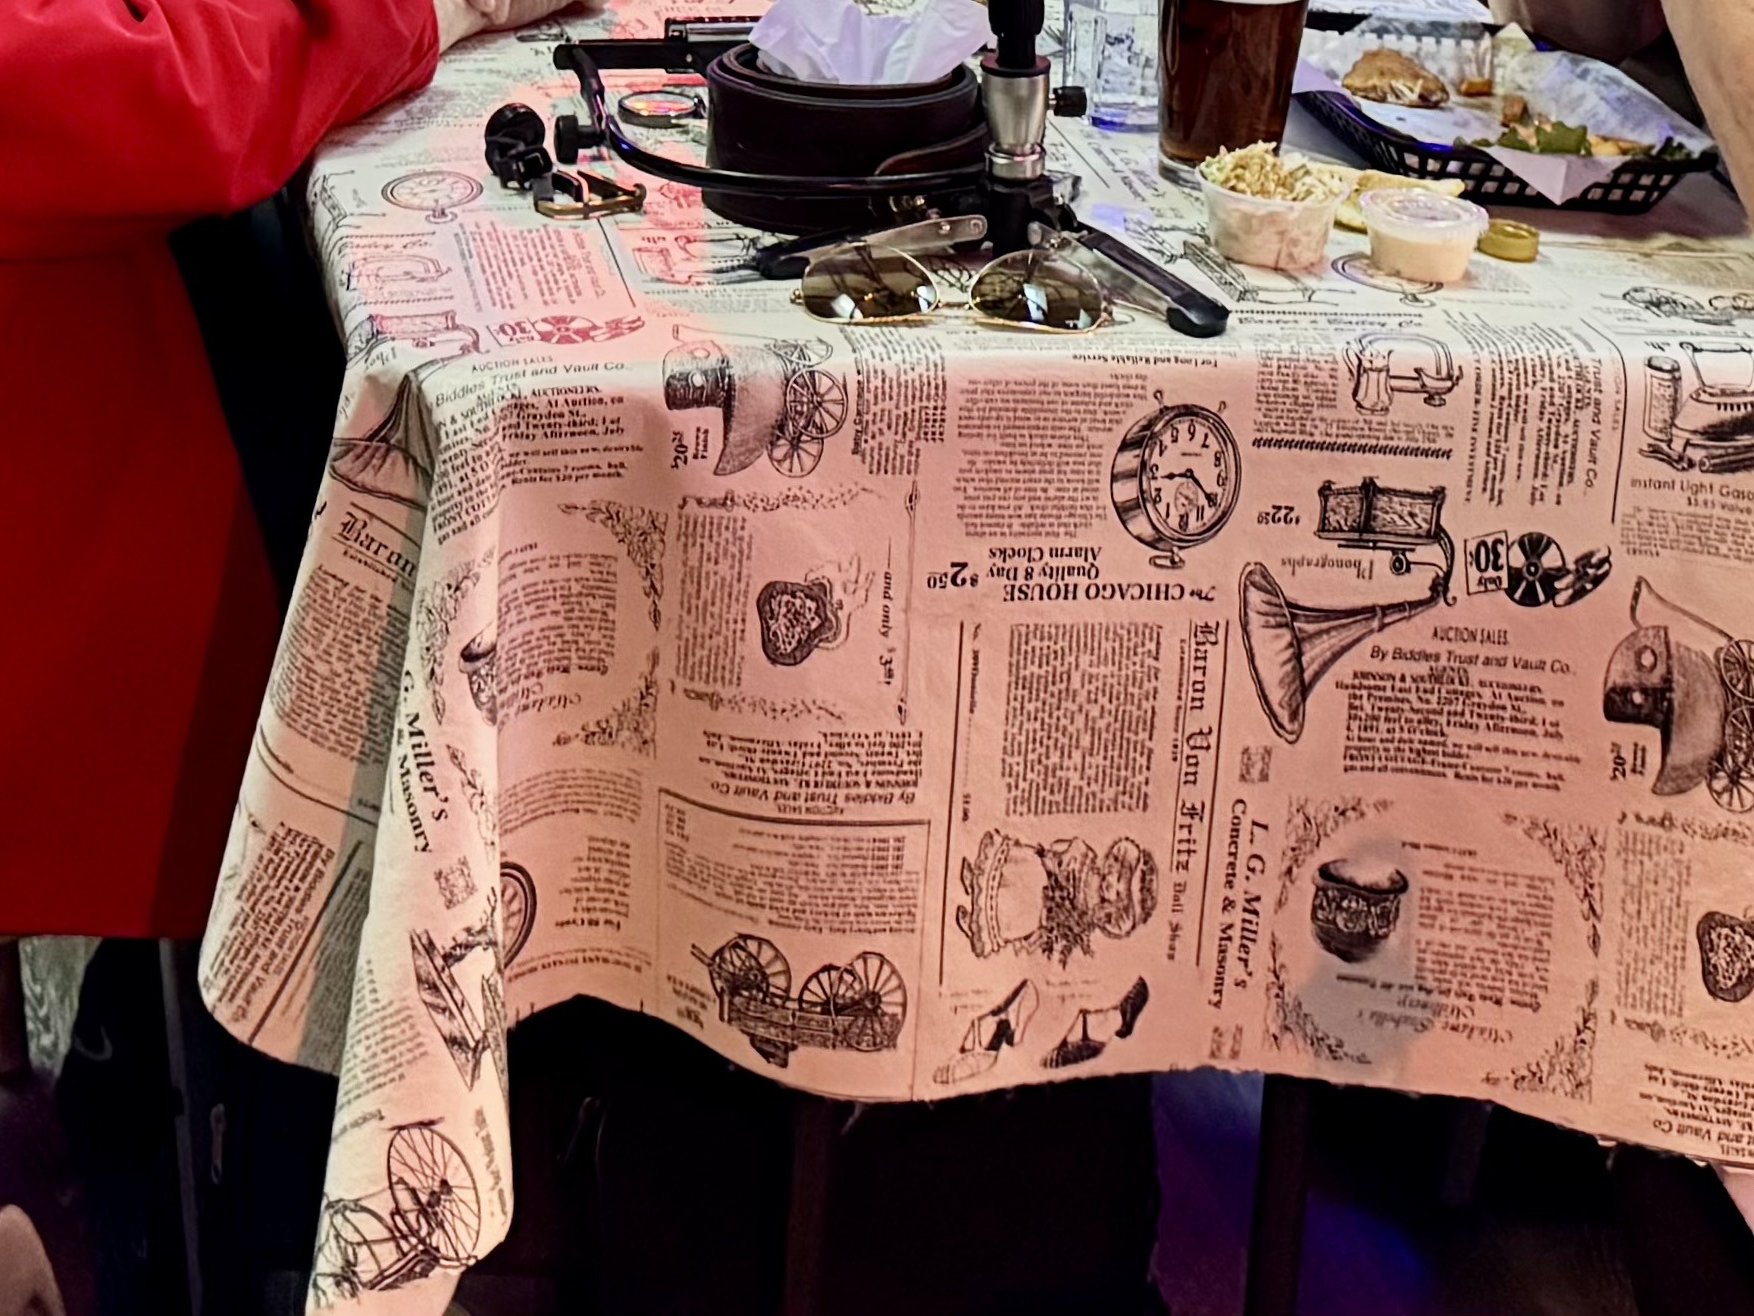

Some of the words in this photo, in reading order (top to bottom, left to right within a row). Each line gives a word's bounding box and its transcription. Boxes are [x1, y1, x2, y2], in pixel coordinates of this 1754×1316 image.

[988, 546, 1044, 562] Clocks
[1049, 546, 1102, 563] Alarm
[985, 564, 1014, 583] Day
[1038, 563, 1100, 583] Quality
[1002, 582, 1079, 603] HOUSE
[1084, 582, 1186, 602] CHICAGO
[1431, 625, 1478, 643] AUCTION
[1187, 619, 1221, 713] Baron
[1369, 645, 1387, 662] By
[1445, 650, 1480, 666] Trust
[1481, 654, 1508, 668] and
[1181, 724, 1214, 787] Von
[1173, 799, 1207, 874] Fritz
[1223, 797, 1249, 892] Concrete
[1220, 901, 1237, 915] &
[1231, 891, 1263, 991] Miller's
[1207, 922, 1235, 1011] Masonry
